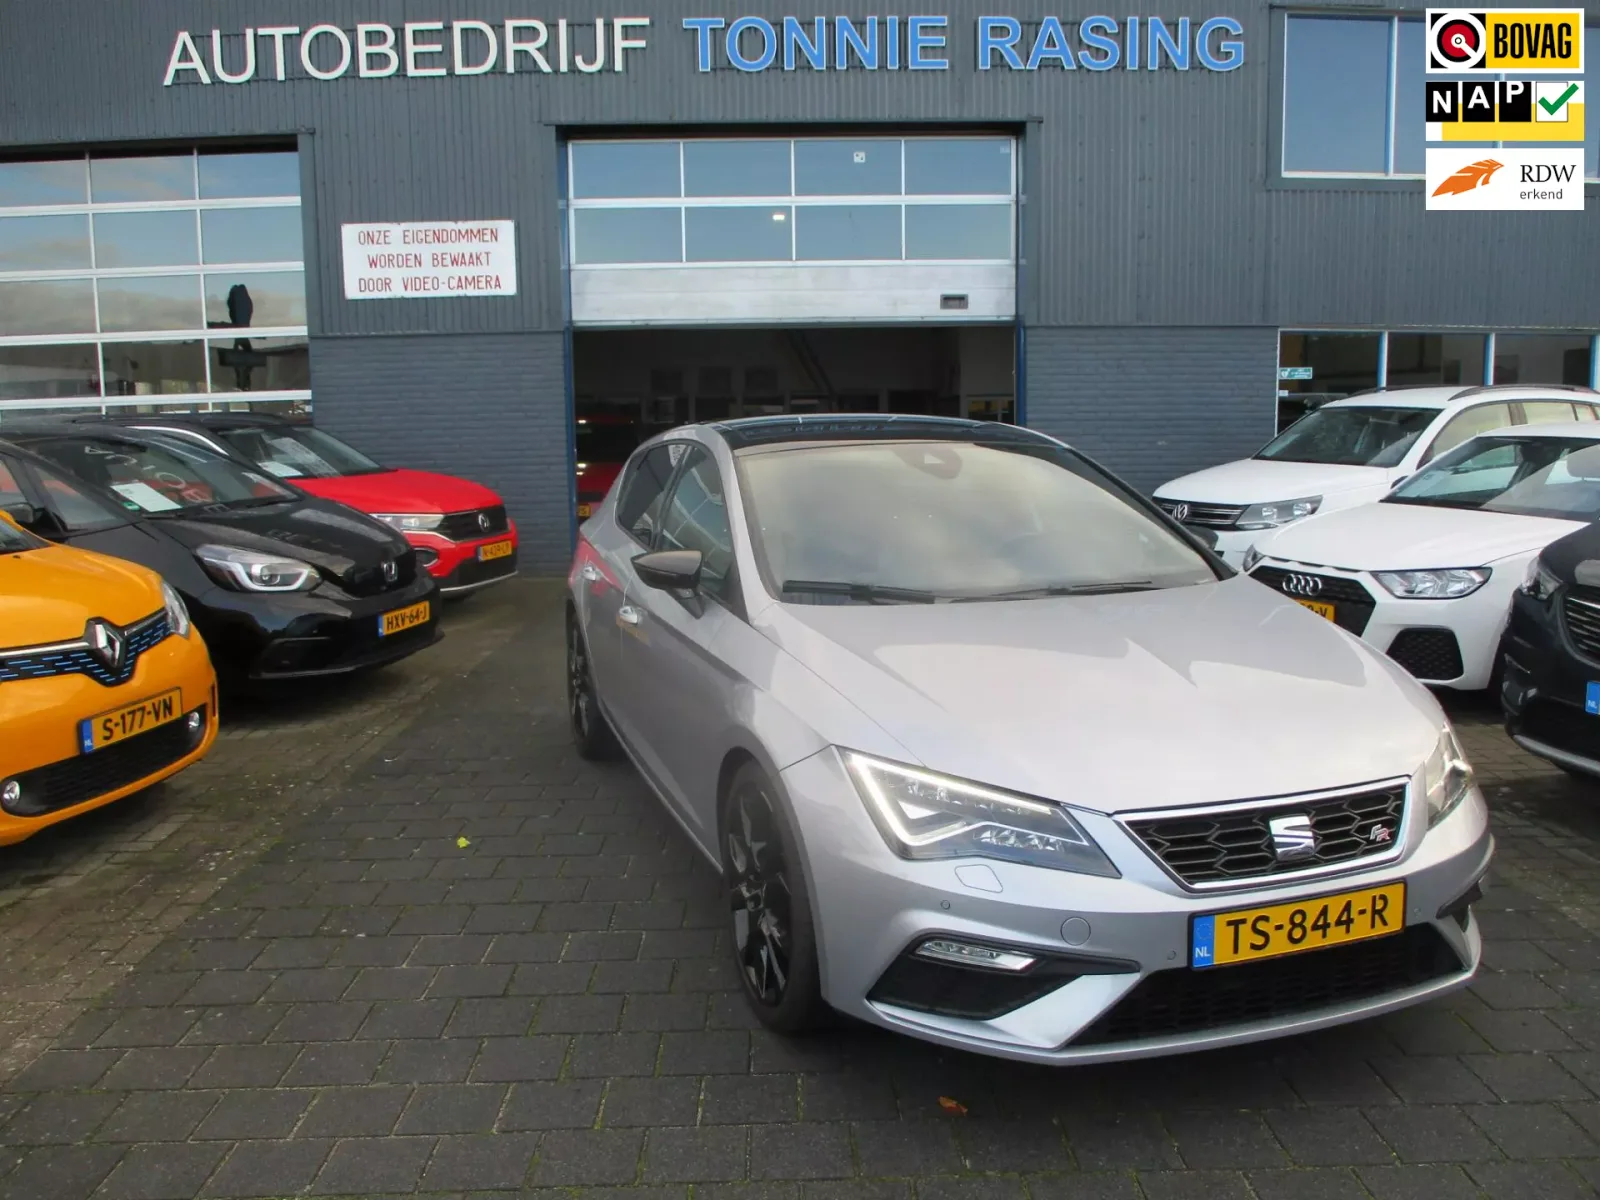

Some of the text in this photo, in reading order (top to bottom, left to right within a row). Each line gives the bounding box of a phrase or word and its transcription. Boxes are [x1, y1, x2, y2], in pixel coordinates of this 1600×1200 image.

[163, 16, 1245, 86] AUTOBEDRIJF TONNIE RASING
[358, 228, 499, 245] ONZE EIGENDOMMEN
[367, 251, 492, 269] WORDEN BEWAAKT
[358, 274, 502, 293] DOOR VIDEO-CAMERA
[386, 605, 428, 632] HXV-64-J
[102, 695, 173, 741] S-177-VN
[1194, 893, 1389, 958] NL TS-844-R
